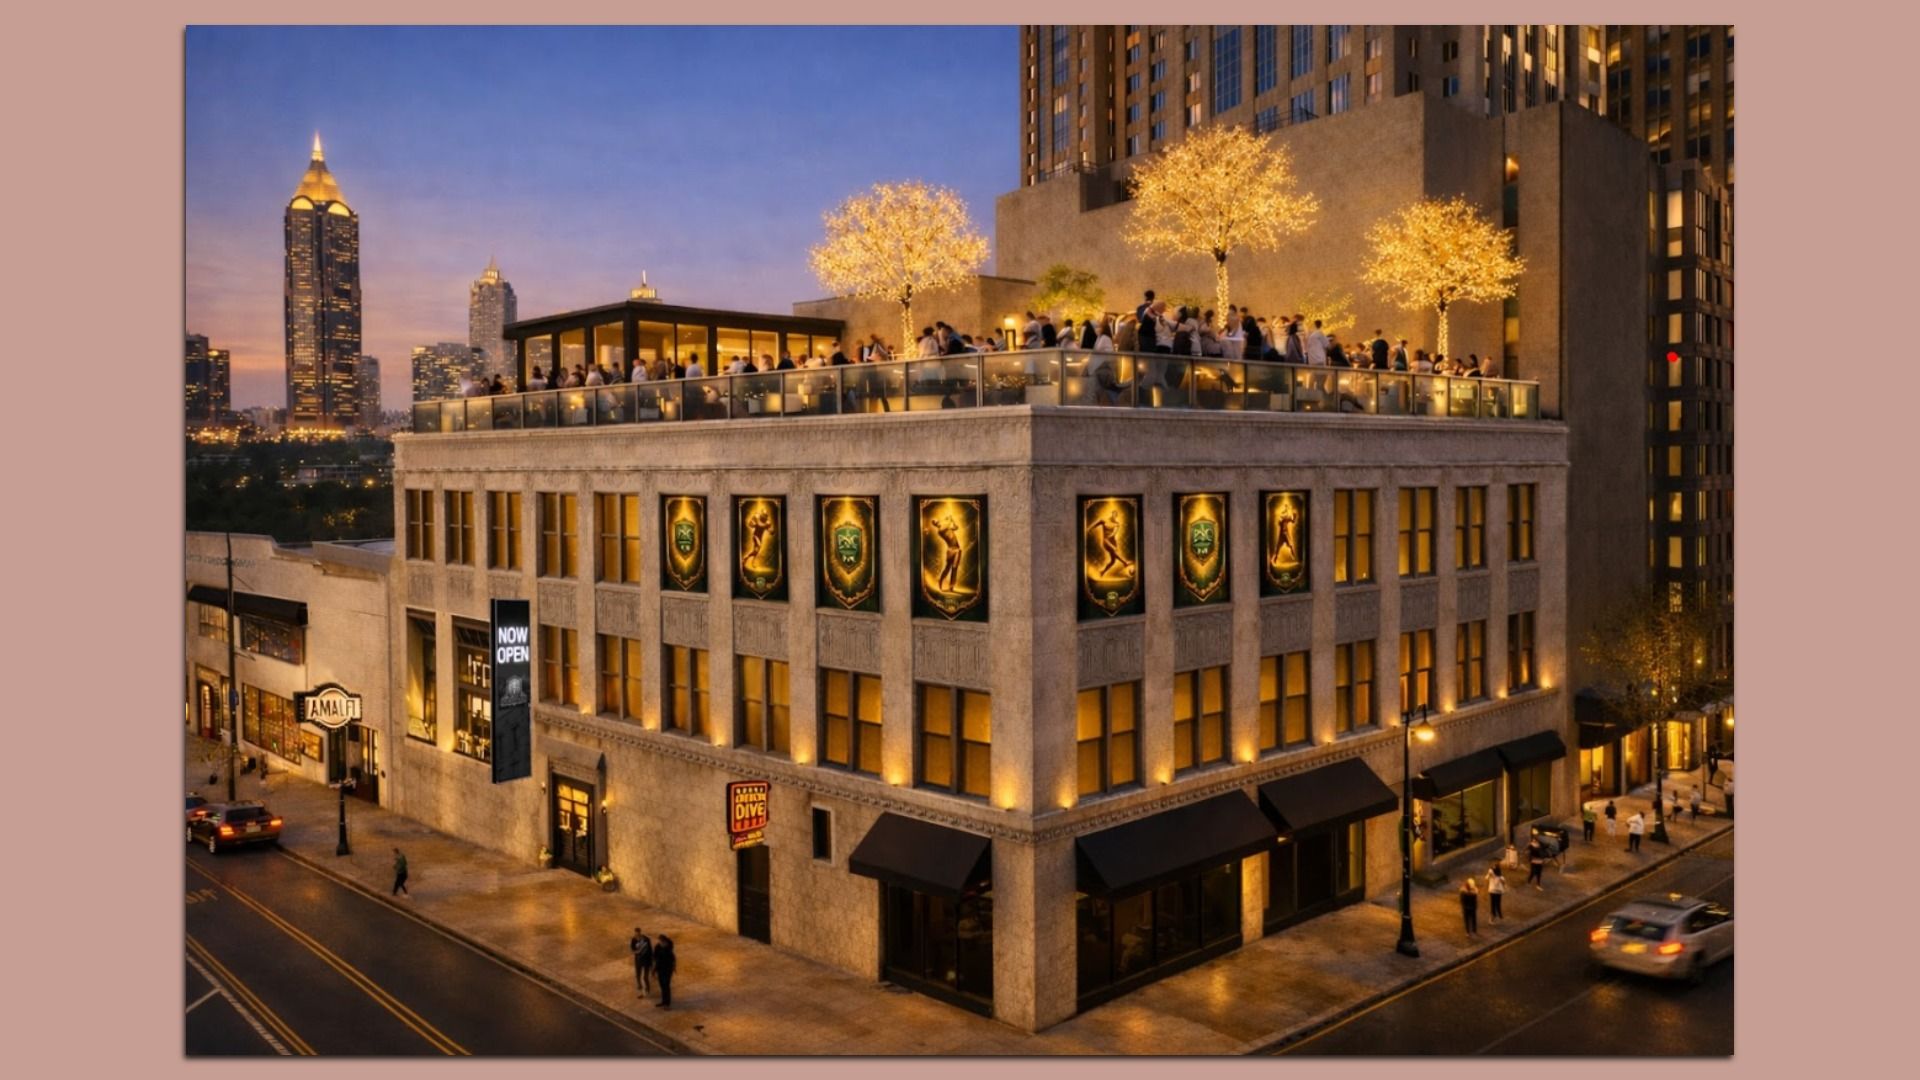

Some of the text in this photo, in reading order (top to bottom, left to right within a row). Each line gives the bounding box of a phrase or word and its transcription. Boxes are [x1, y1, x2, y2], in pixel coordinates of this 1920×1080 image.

[498, 627, 528, 644] NOW
[497, 646, 529, 663] OPEN
[735, 802, 765, 820] DIVE
